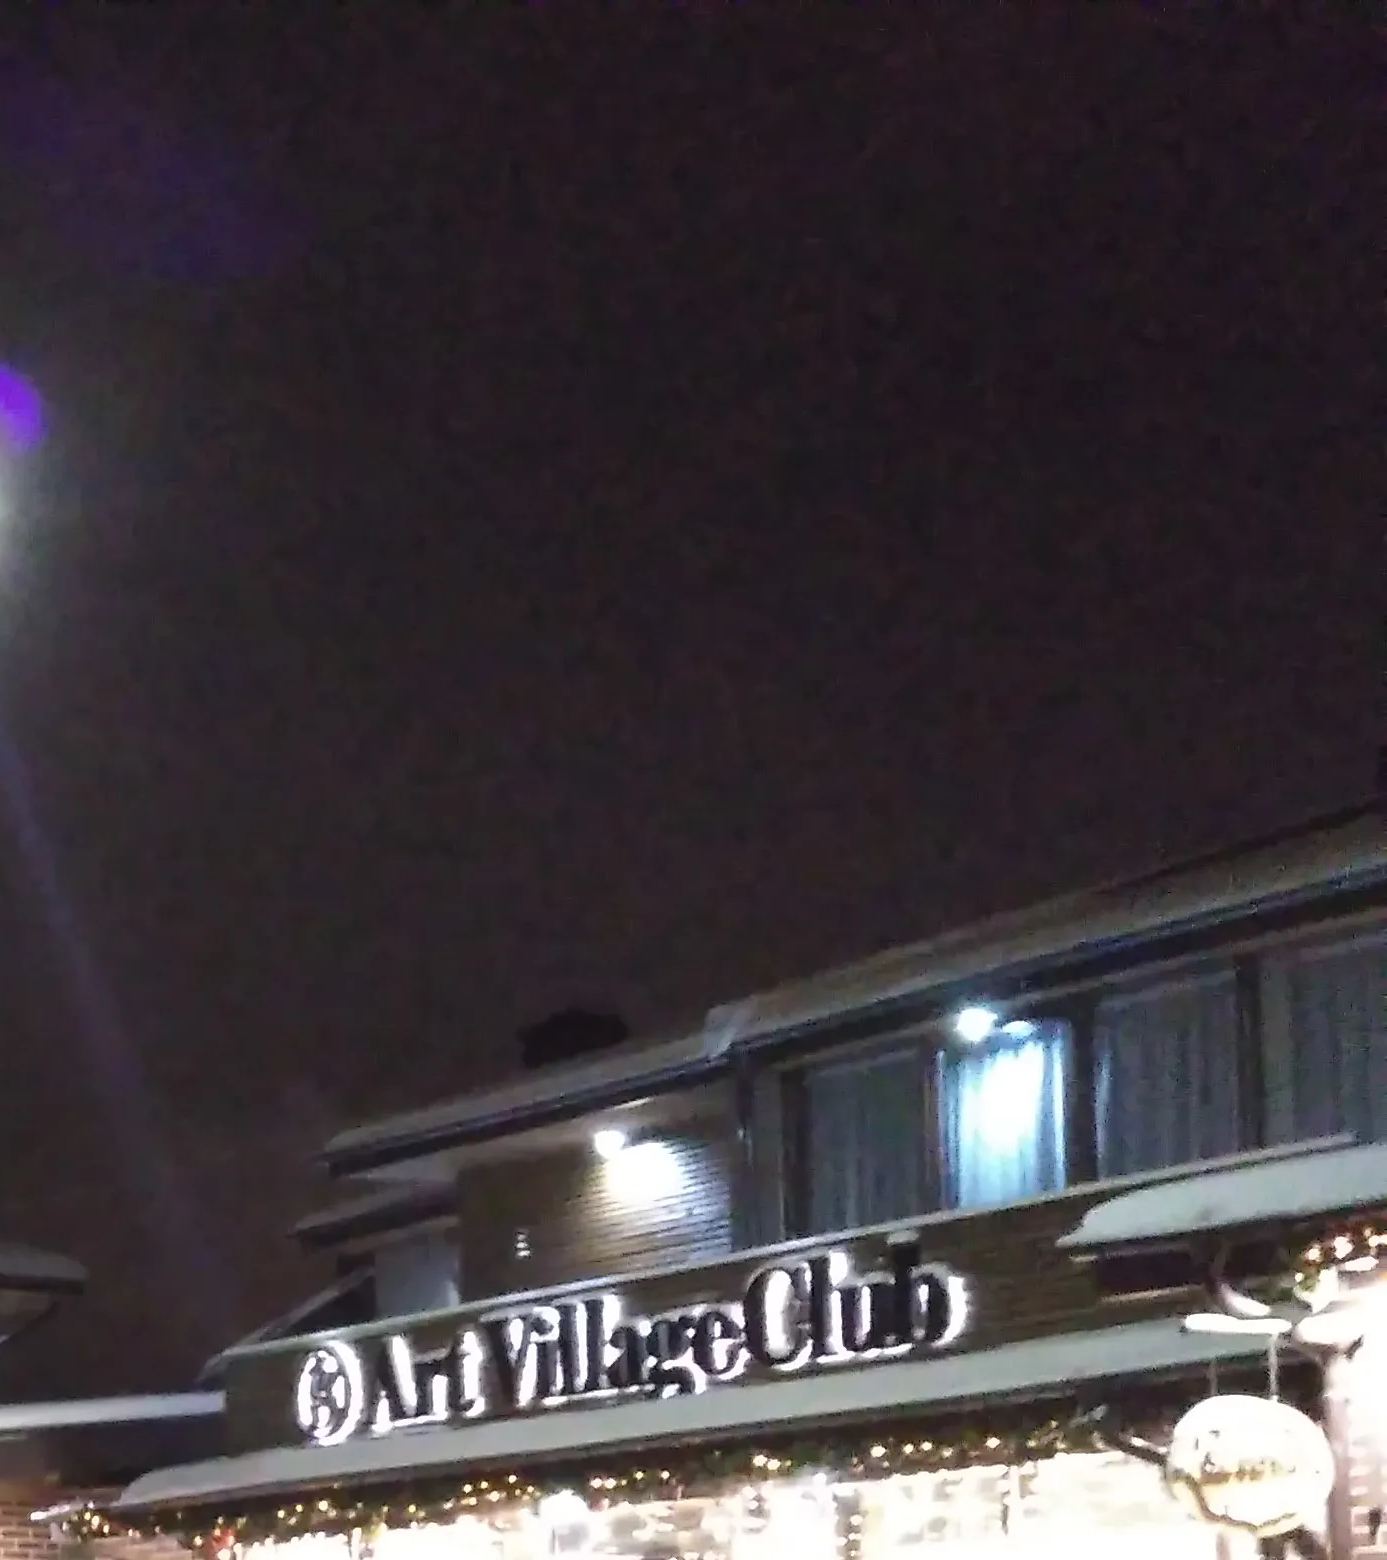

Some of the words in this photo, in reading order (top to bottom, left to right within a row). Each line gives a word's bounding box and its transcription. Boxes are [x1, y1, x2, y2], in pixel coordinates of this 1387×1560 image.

[367, 1328, 486, 1437] Art
[479, 1290, 751, 1400] Village
[743, 1230, 969, 1372] Club
